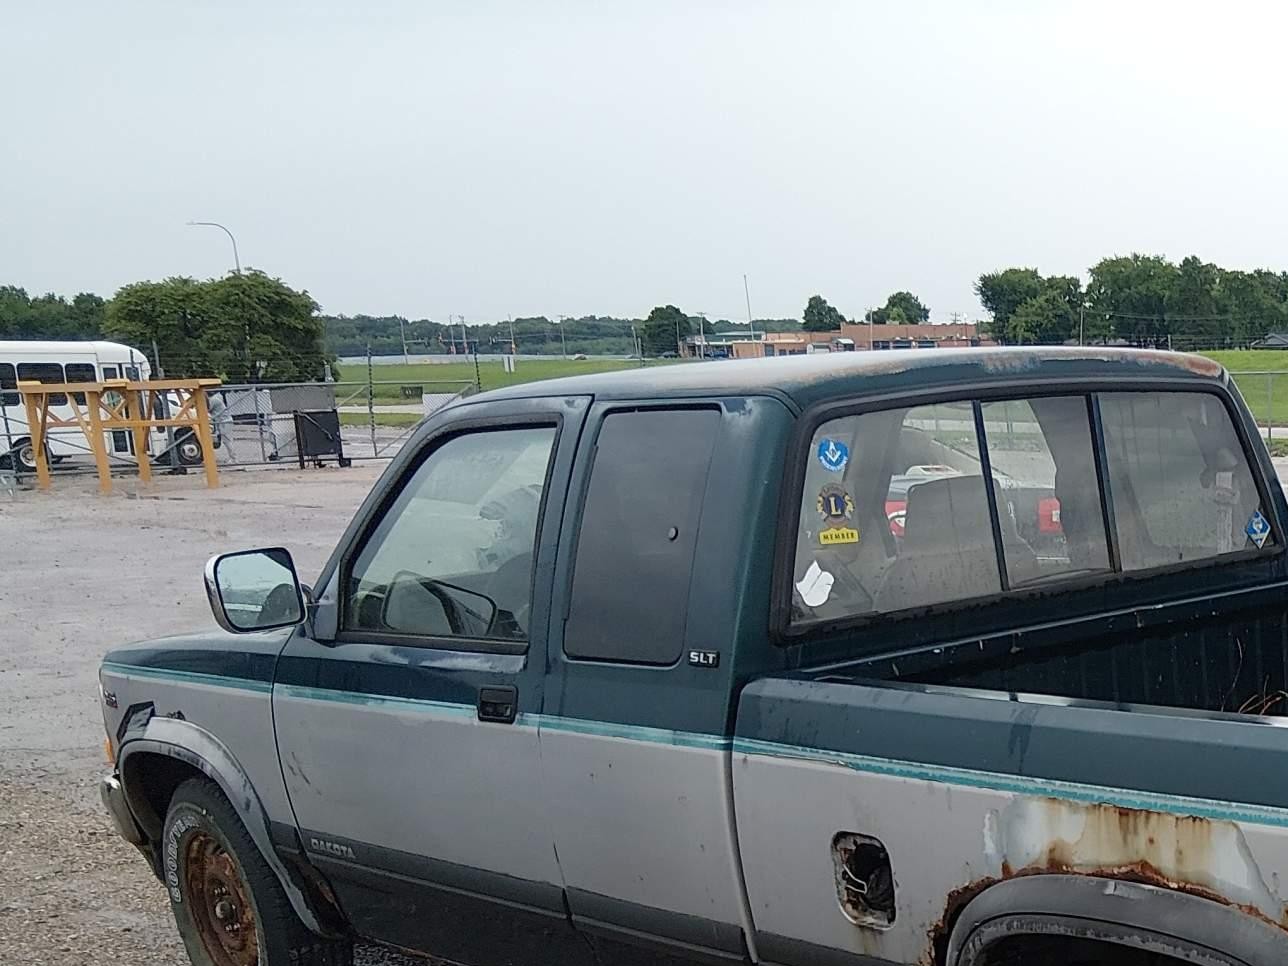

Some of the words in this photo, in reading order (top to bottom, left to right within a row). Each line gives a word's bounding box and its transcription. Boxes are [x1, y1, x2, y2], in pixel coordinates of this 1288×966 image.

[823, 531, 855, 541] MEMBER
[690, 651, 716, 665] SLT
[311, 838, 356, 859] DAKOTA
